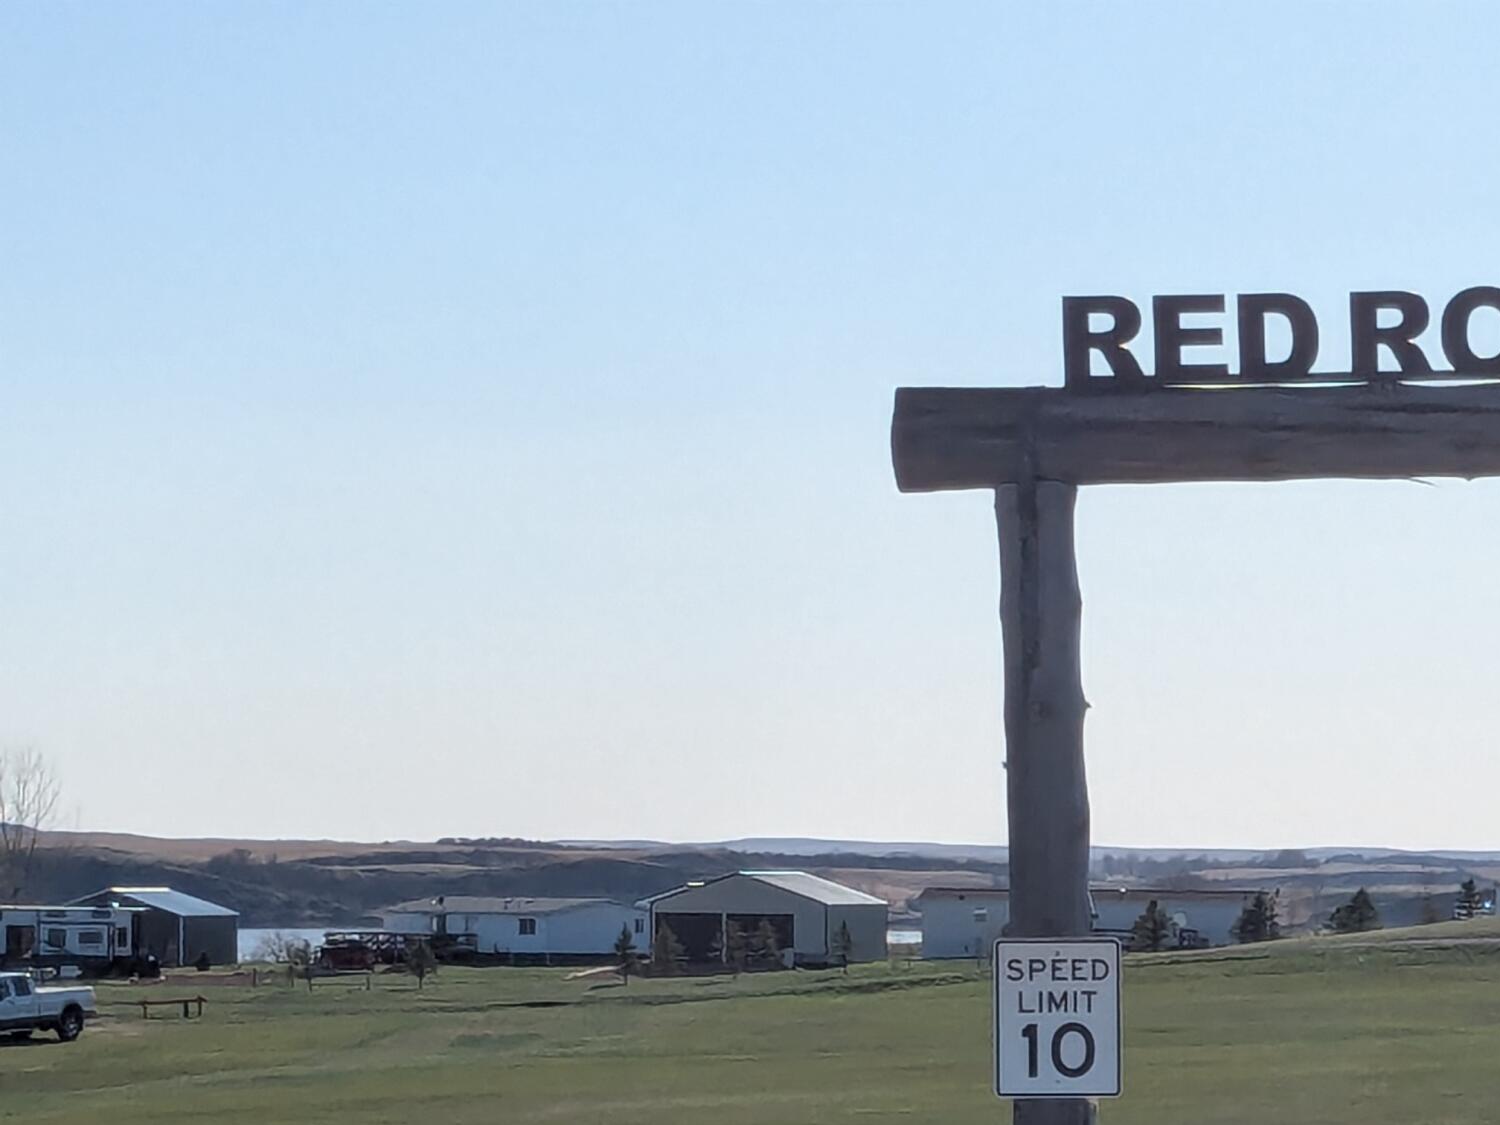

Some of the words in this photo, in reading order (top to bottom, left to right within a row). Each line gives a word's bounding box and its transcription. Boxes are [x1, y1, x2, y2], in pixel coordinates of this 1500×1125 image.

[1062, 293, 1319, 386] RED
[1006, 958, 1110, 982] SPEED
[1017, 990, 1098, 1014] LIMIT
[1021, 1022, 1096, 1078] 10
